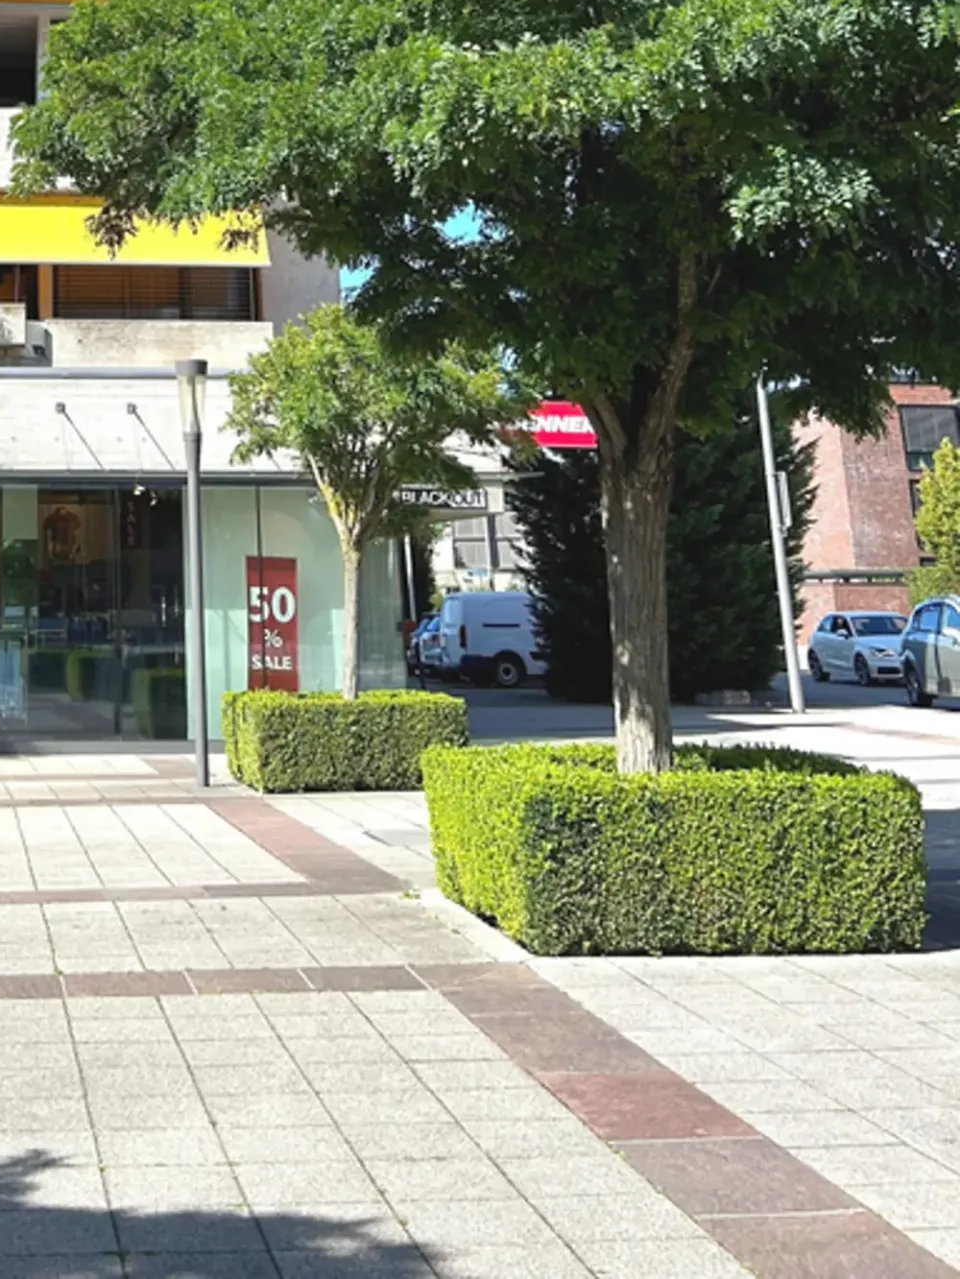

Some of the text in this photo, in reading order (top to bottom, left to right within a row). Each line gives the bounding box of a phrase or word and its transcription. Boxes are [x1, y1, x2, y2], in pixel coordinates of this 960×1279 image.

[249, 586, 295, 623] 50
[263, 628, 284, 648] %
[251, 654, 292, 670] SALE
